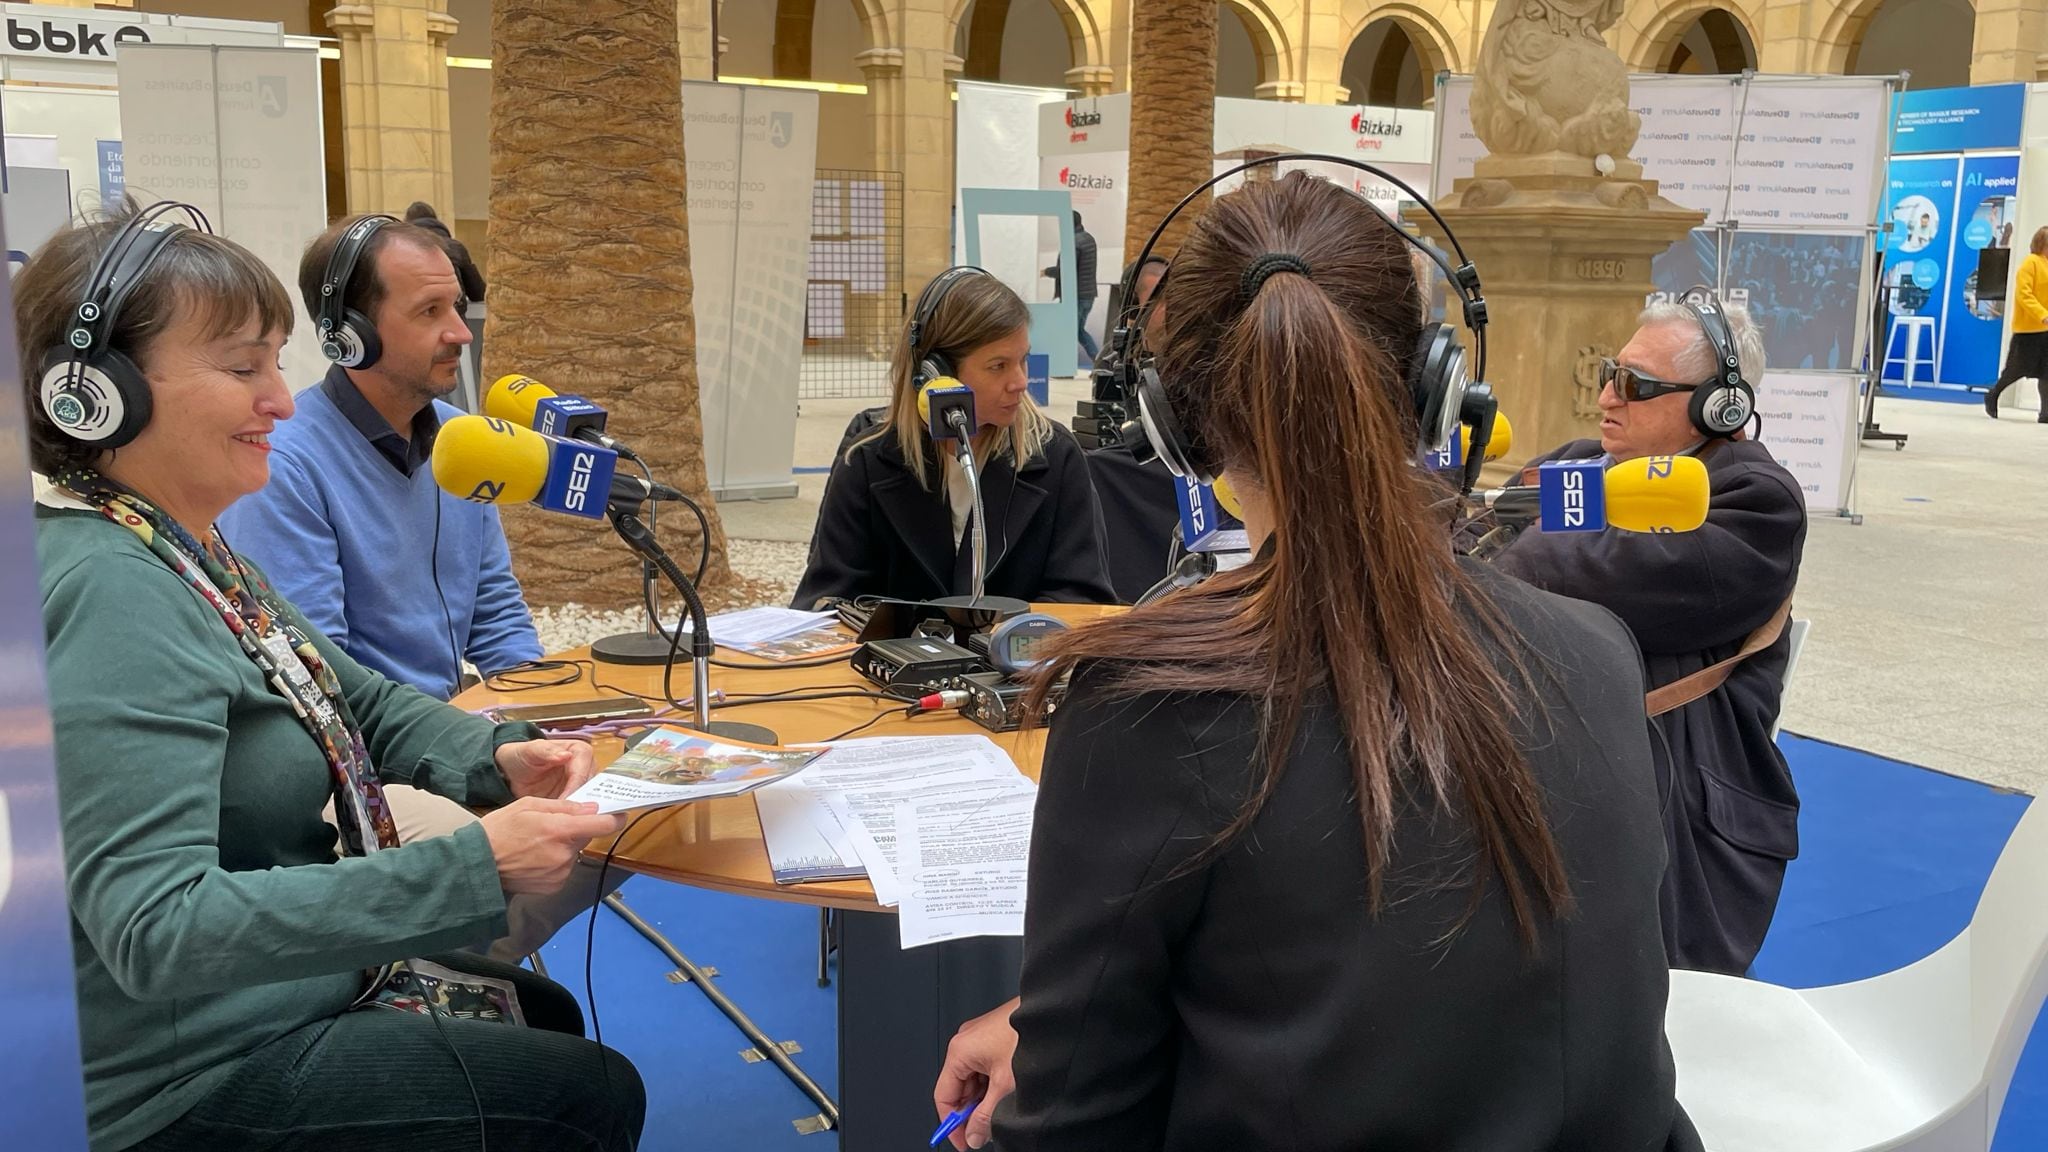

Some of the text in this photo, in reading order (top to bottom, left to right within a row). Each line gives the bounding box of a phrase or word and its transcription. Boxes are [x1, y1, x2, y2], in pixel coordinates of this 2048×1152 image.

[7, 19, 109, 56] bbk
[1071, 111, 1101, 128] Bizkaia
[1359, 119, 1403, 136] Bizkaia
[1067, 173, 1113, 190] Bizkaia
[1941, 180, 1952, 188] on
[1965, 173, 2016, 189] AI applied
[565, 452, 595, 512] SER
[1563, 470, 1584, 528] SER
